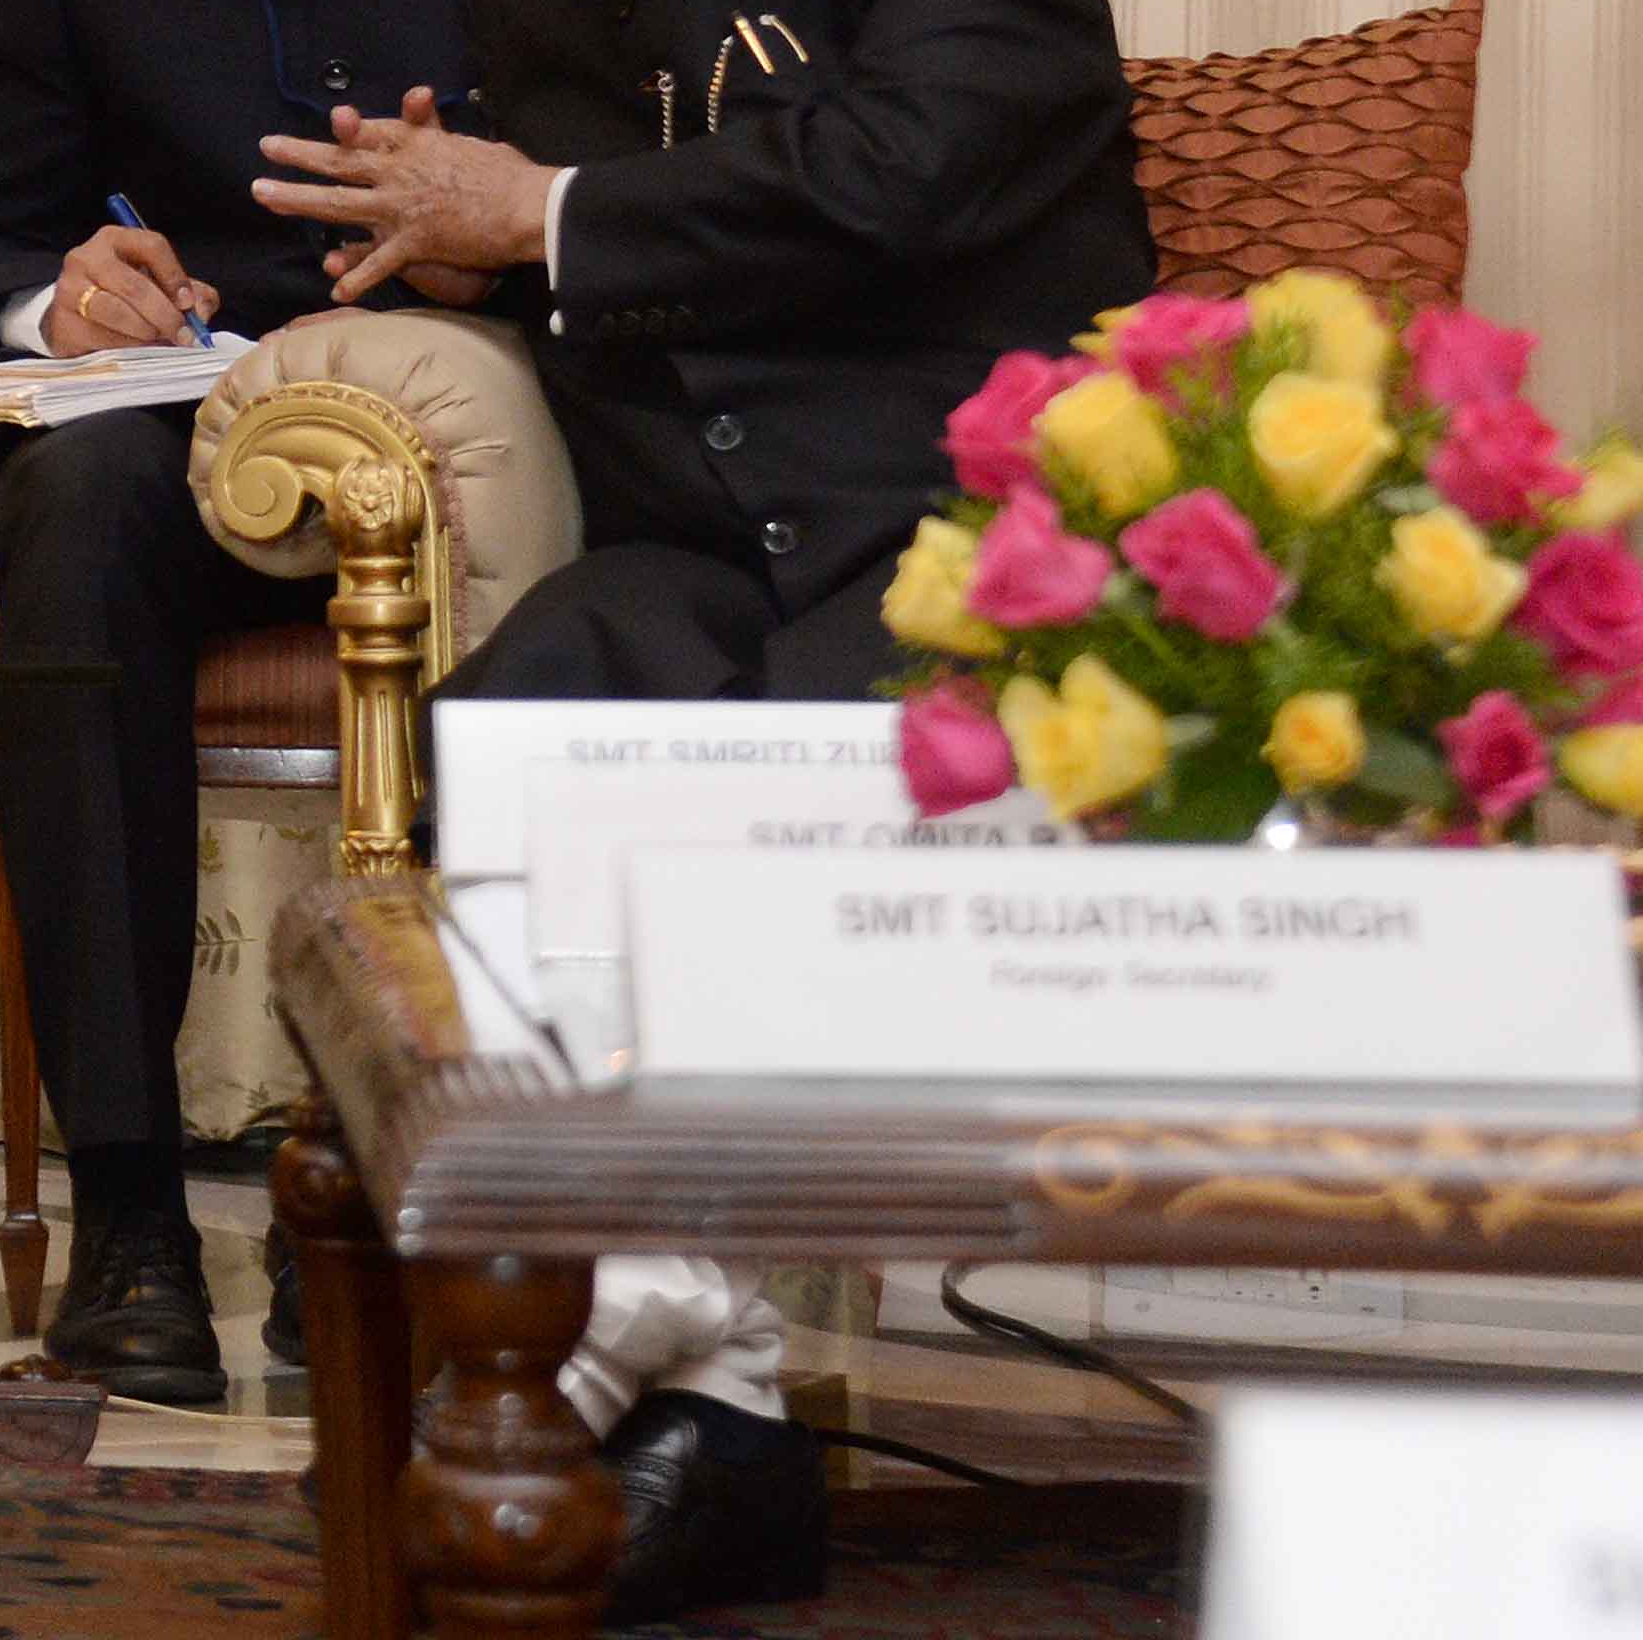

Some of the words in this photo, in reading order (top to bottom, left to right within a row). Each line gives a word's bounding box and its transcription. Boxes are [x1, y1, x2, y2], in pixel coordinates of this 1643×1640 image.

[835, 892, 947, 937] SMT
[967, 893, 1223, 937] SUJATHA
[1237, 894, 1421, 939] SINGH
